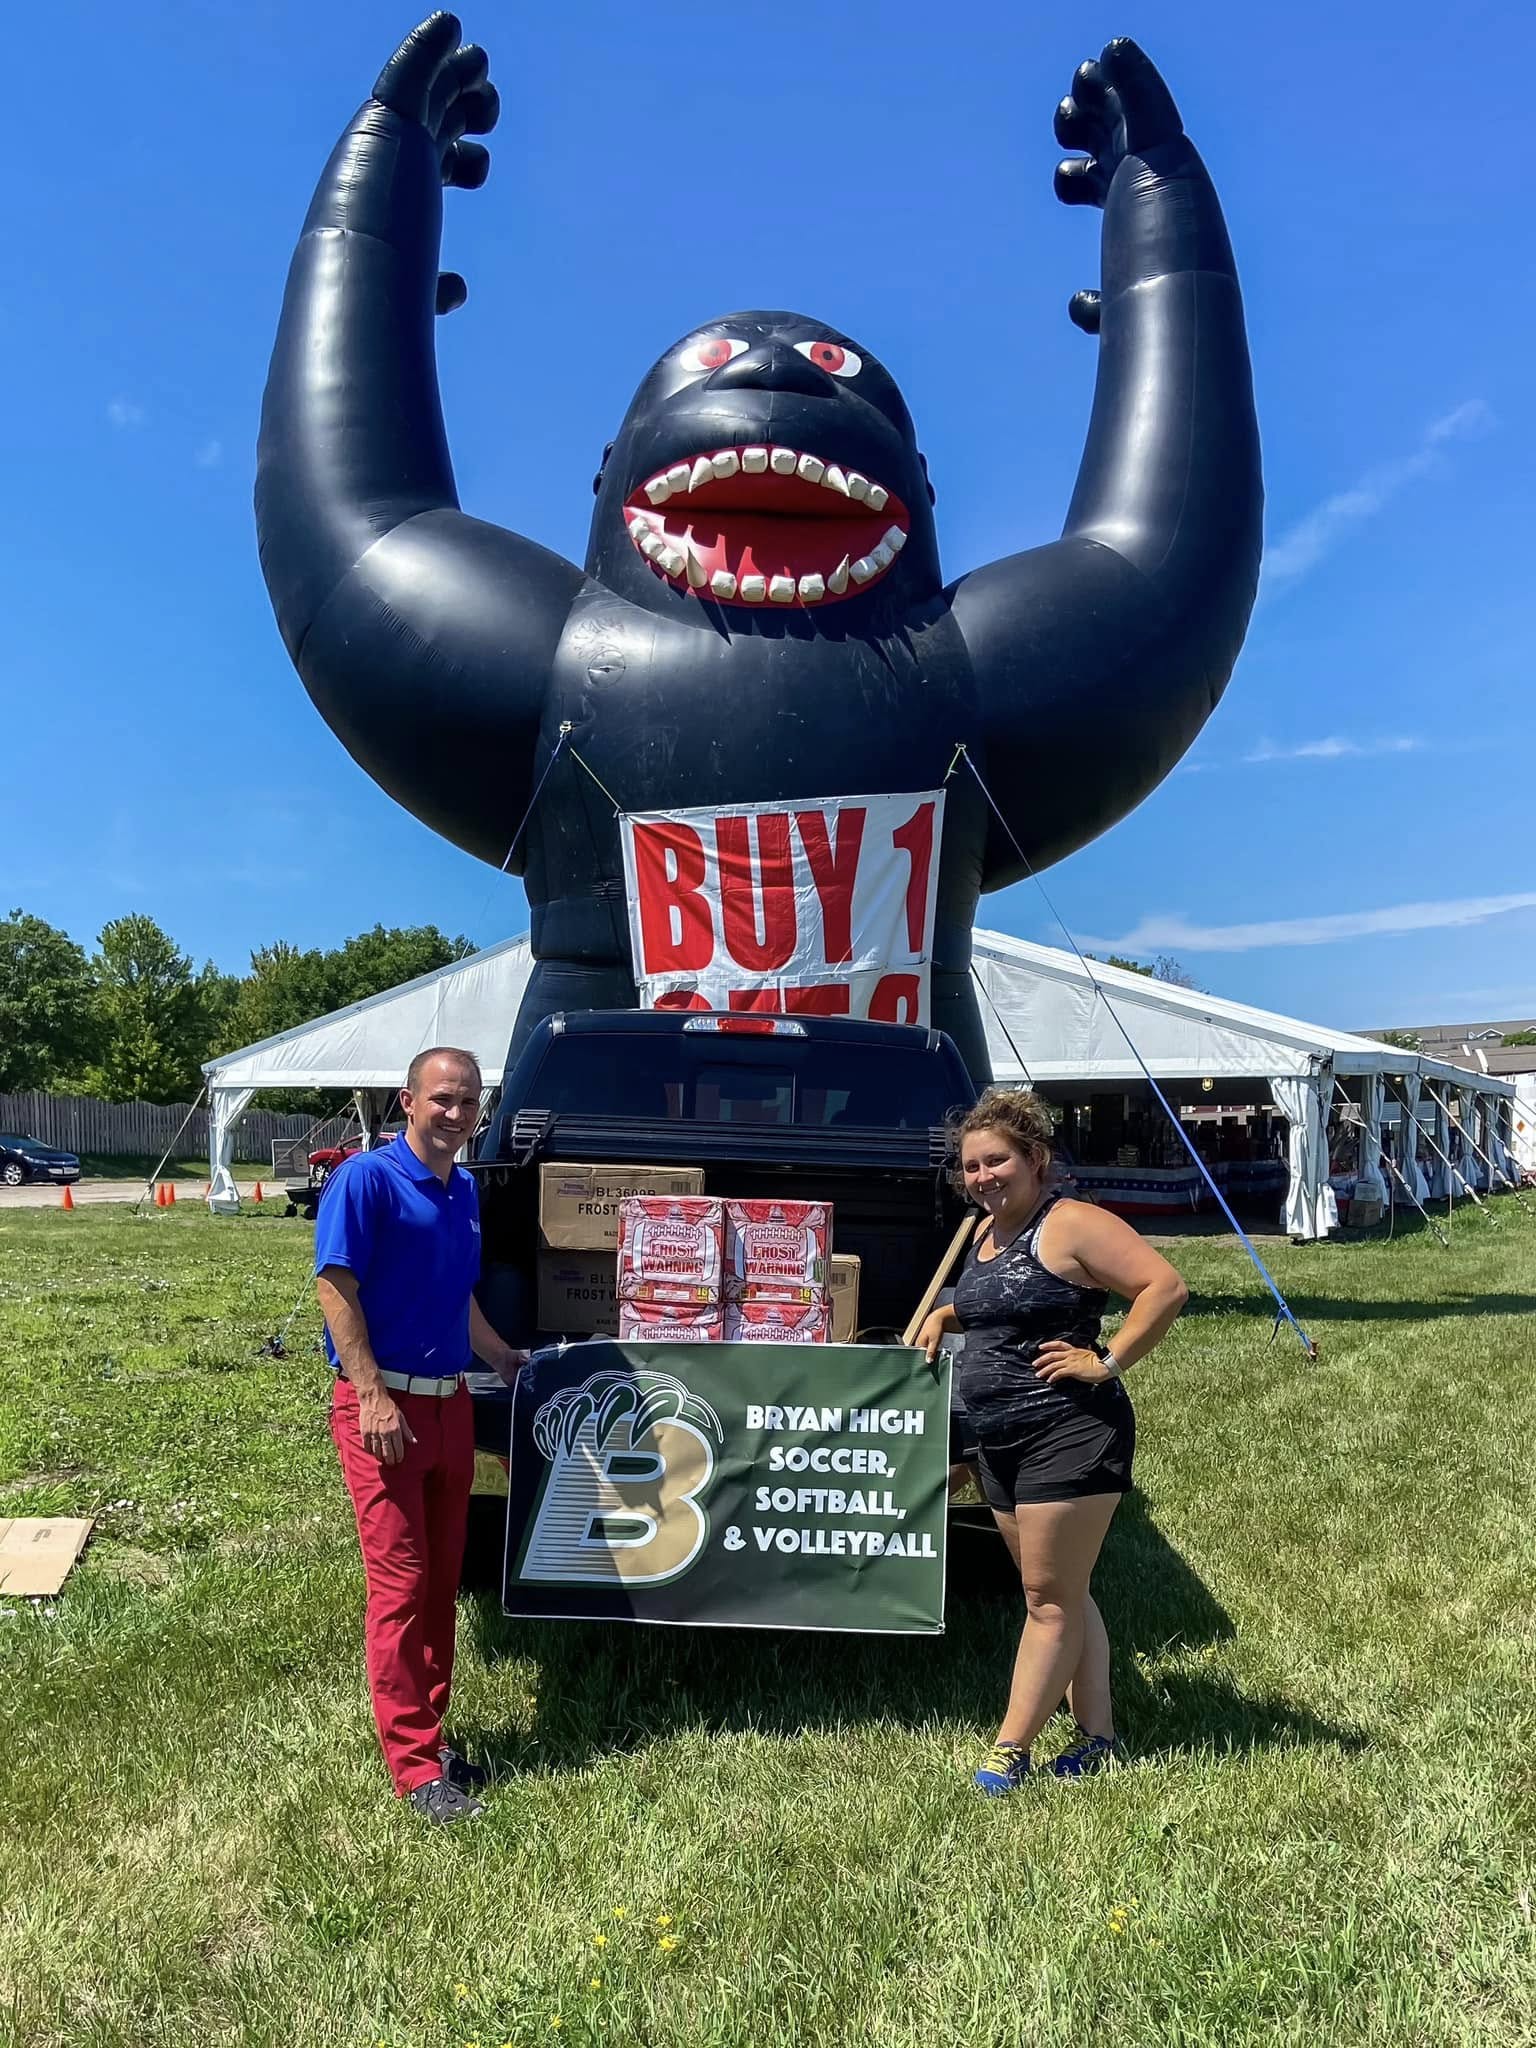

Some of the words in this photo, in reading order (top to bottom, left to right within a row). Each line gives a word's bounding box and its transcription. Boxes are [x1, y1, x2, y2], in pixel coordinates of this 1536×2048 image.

[632, 807, 867, 975] BUY
[892, 801, 936, 954] 1
[578, 1203, 618, 1215] FROST
[650, 1241, 699, 1258] FROST
[752, 1244, 799, 1259] FROST
[642, 1258, 706, 1274] WARNING
[745, 1260, 805, 1275] WARNING
[566, 1287, 606, 1301] FROST
[746, 1405, 842, 1432] BRYAN
[850, 1408, 925, 1435] HIGH
[769, 1446, 897, 1478] SOCCER,
[755, 1486, 908, 1520] SOFTBALL,
[722, 1525, 747, 1551] &
[752, 1526, 938, 1558] VOLLEYBALL
